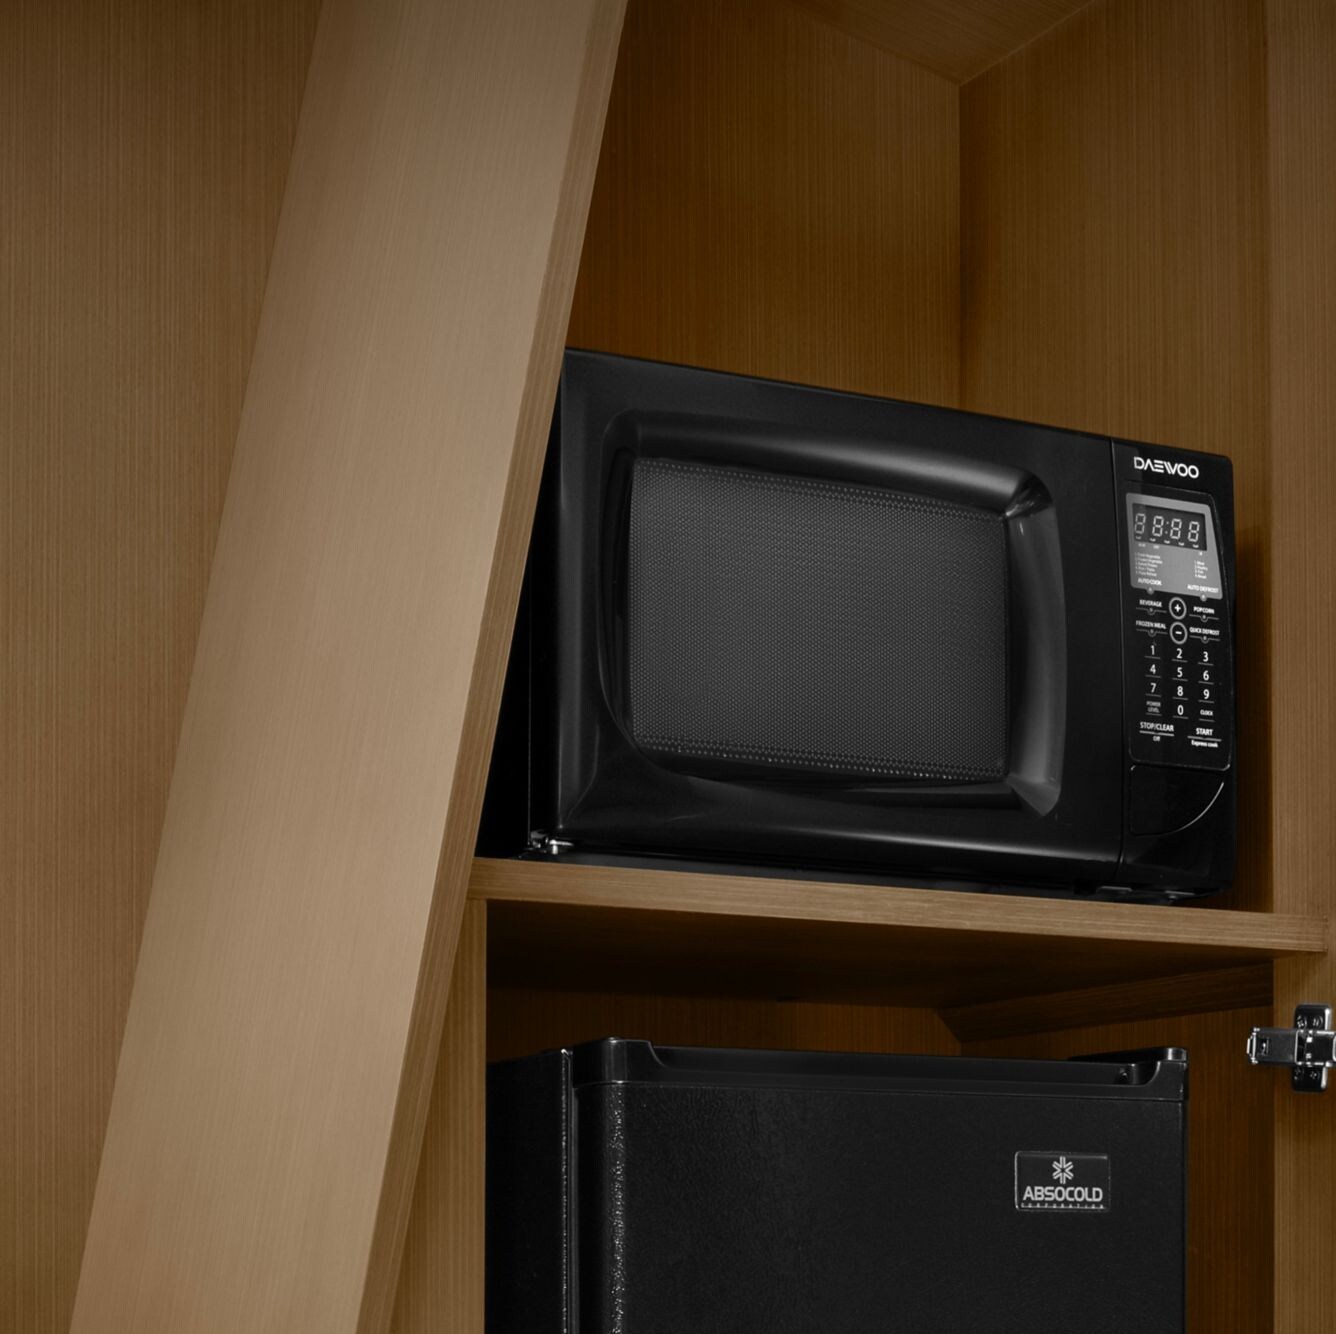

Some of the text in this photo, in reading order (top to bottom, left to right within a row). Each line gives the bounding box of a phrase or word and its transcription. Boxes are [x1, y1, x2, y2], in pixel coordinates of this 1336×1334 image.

[1133, 456, 1200, 479] DAEWOO
[1139, 599, 1163, 608] BEVERAGE
[1193, 606, 1215, 615] POPCORN
[1136, 620, 1167, 630] FROZEN MEAL
[1189, 626, 1220, 636] QUICK DEFROST
[1150, 644, 1155, 656] 1
[1176, 647, 1183, 659] 2
[1202, 651, 1209, 662] 3
[1149, 664, 1157, 675] 4
[1176, 666, 1183, 678] 5
[1202, 670, 1210, 681] 6
[1150, 682, 1157, 693] 7
[1176, 685, 1184, 697] 8
[1203, 688, 1210, 700] 9
[1177, 704, 1184, 716] 0
[1200, 709, 1213, 717] CLOCK
[1140, 721, 1175, 732] STOP/CLEAR
[1195, 727, 1213, 736] START
[1023, 1185, 1103, 1202] ABSOCOLD
